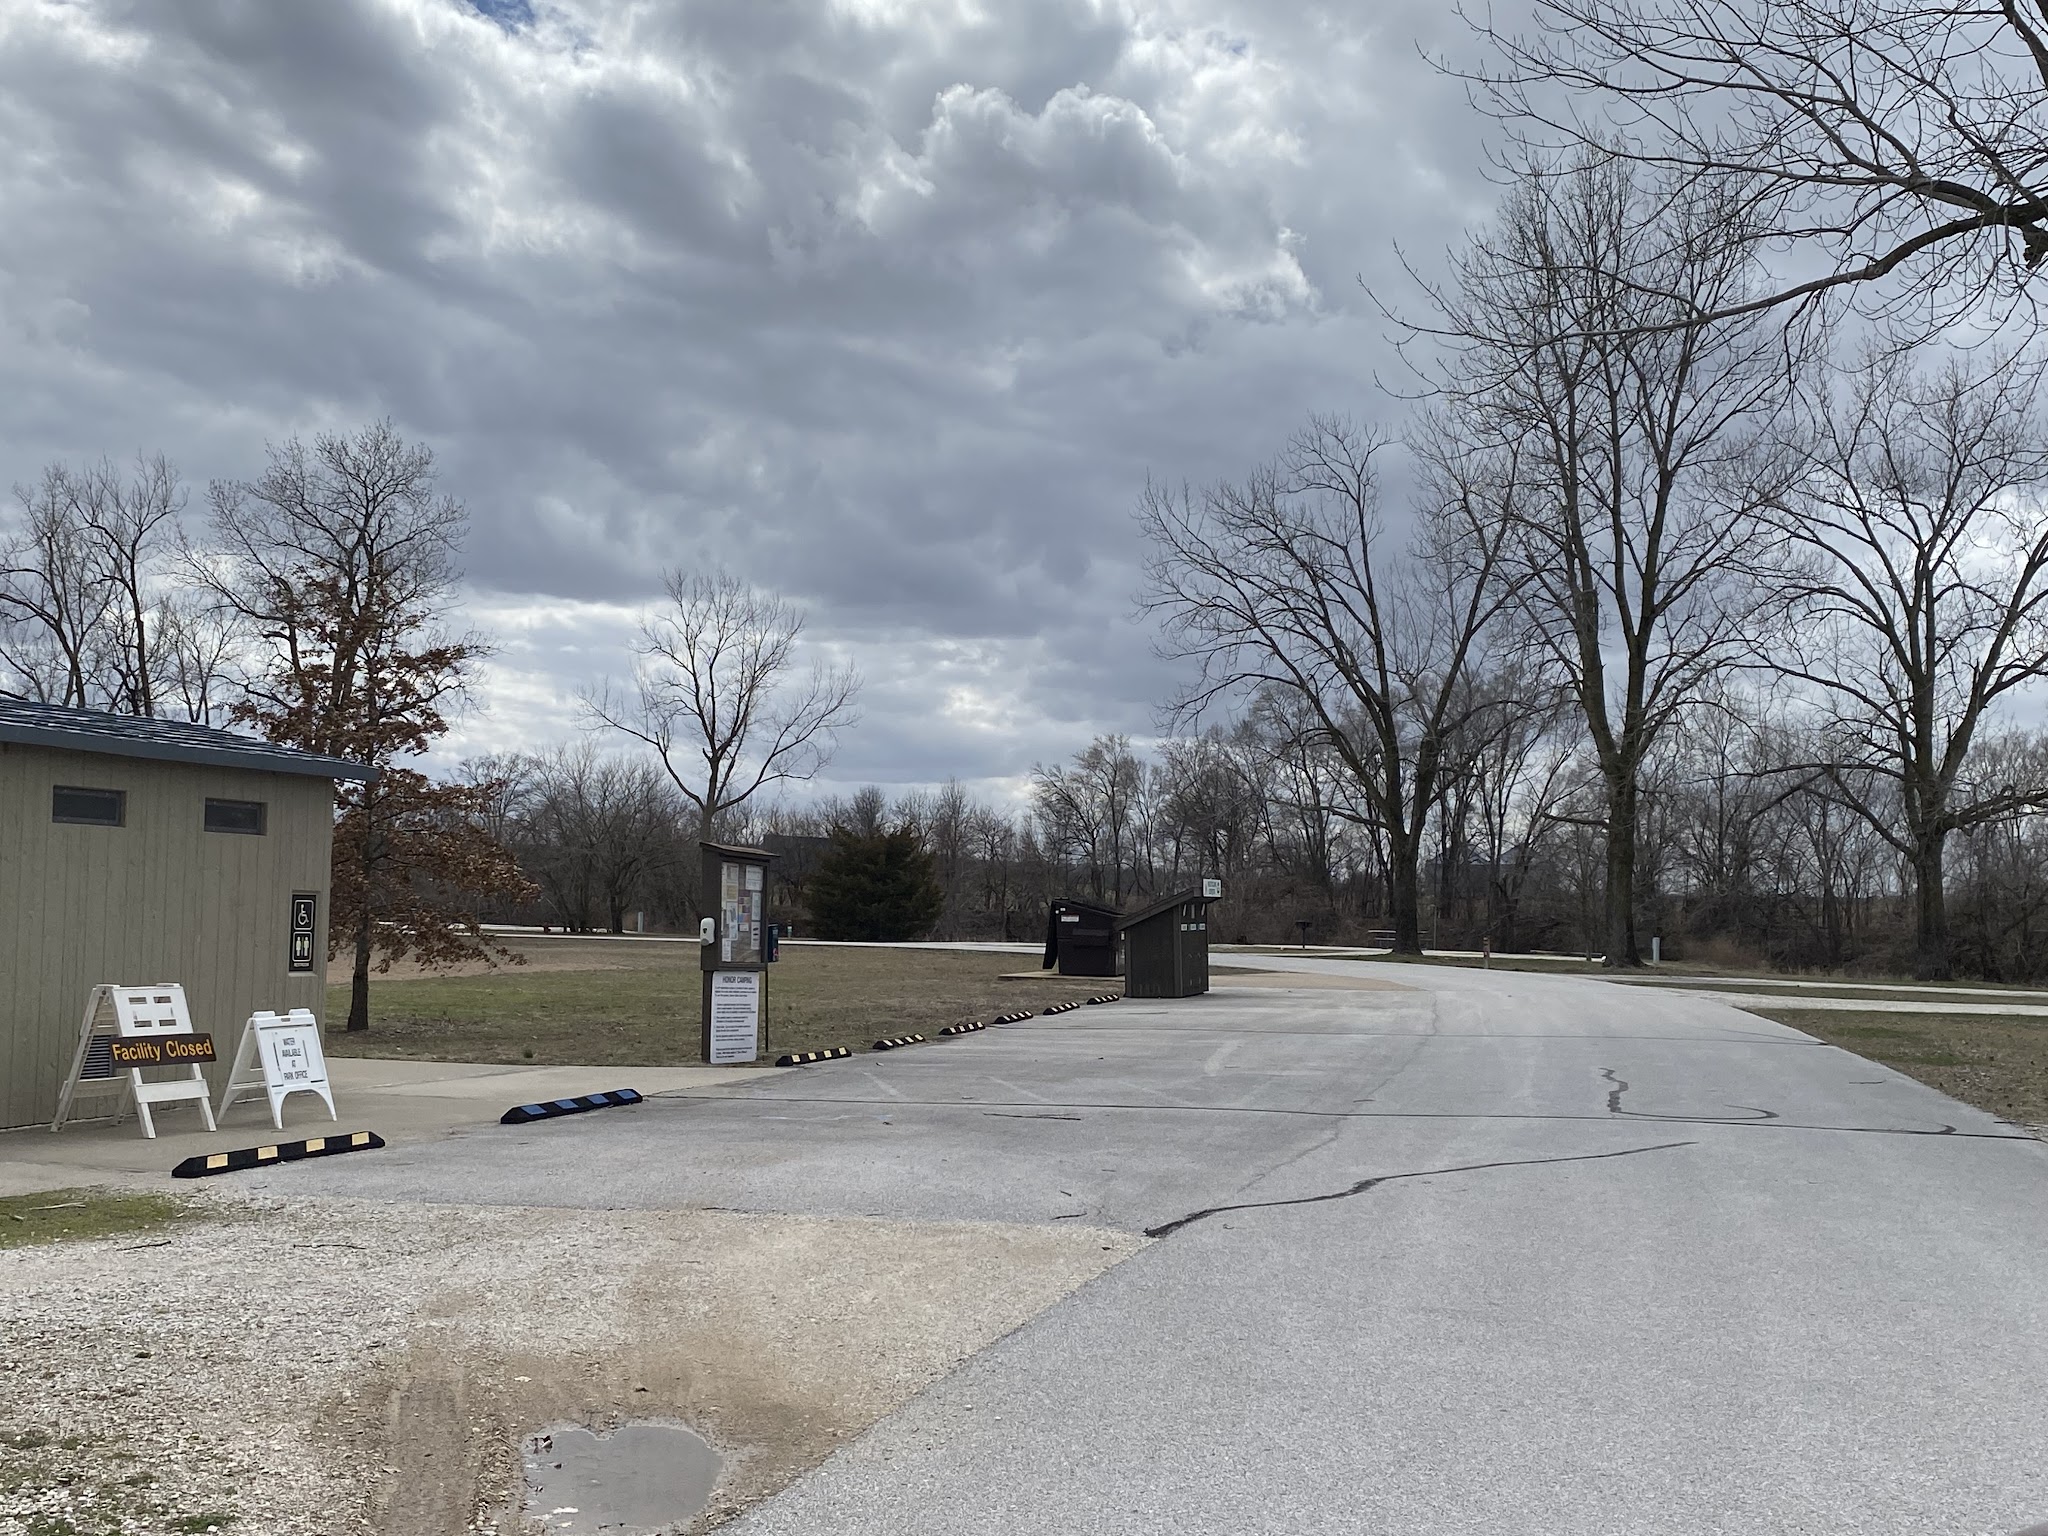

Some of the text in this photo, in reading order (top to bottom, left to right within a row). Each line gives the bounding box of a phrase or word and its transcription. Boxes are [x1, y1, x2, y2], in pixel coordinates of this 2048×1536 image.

[282, 1038, 296, 1046] WATER
[112, 1039, 213, 1062] Facility Closed
[282, 1048, 301, 1057] AVAILABLE
[284, 1070, 308, 1080] PARK OFFICE
